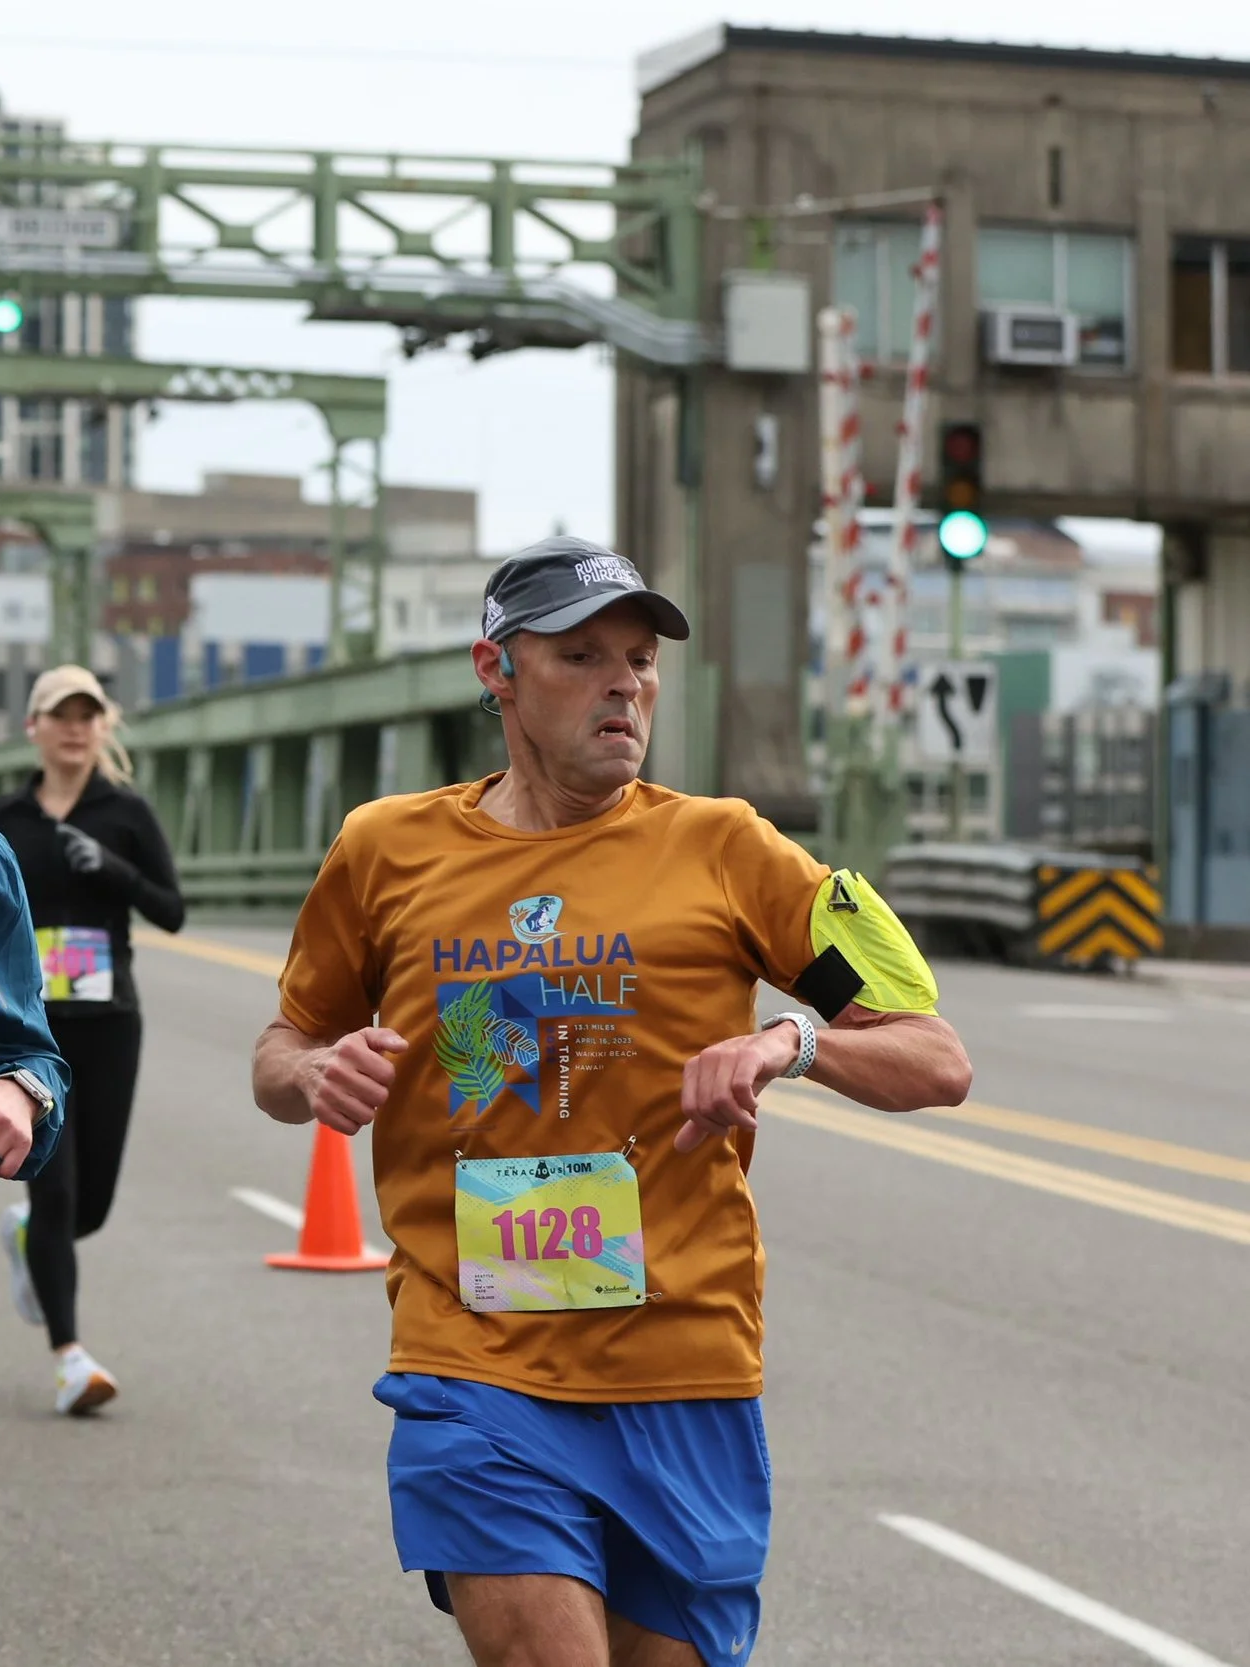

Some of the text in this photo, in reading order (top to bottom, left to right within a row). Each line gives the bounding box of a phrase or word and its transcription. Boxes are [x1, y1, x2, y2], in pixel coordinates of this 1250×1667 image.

[575, 556, 622, 581] RUN WITH
[583, 567, 638, 587] PURPOSE
[433, 933, 636, 972] HAPALUA
[539, 974, 638, 1007] HALF
[558, 1024, 570, 1119] IN TRAINING
[566, 1162, 593, 1174] 10M
[492, 1205, 603, 1261] 1128
